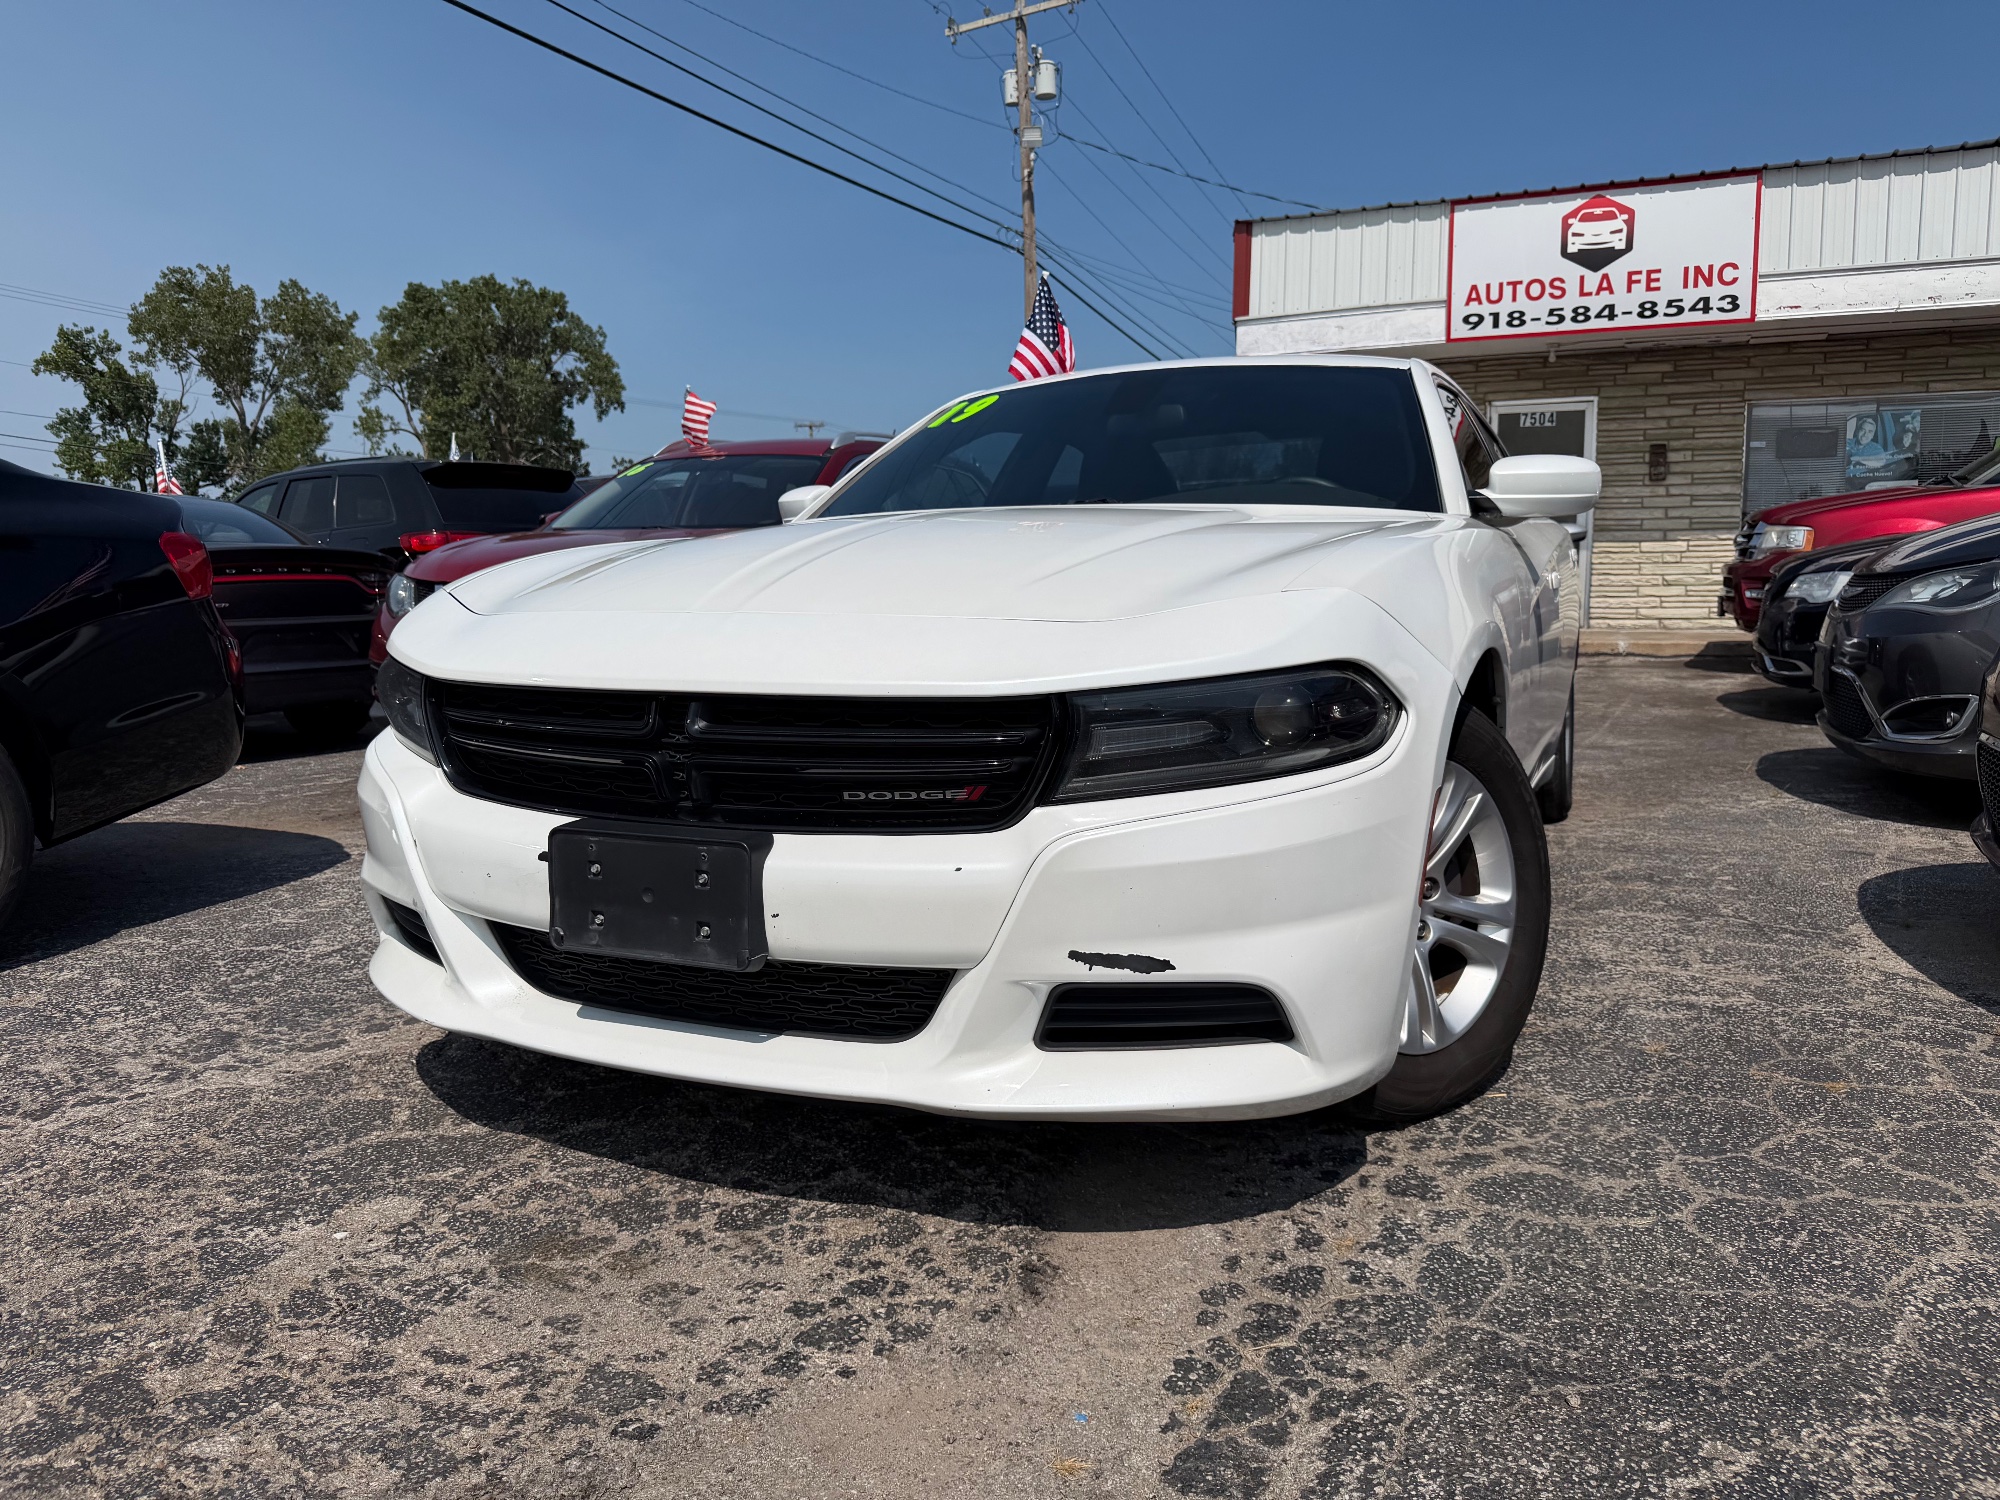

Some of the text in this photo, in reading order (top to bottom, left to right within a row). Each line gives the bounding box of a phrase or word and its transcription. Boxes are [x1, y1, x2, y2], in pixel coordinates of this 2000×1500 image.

[1464, 262, 1740, 307] AUTOS LA FE INC
[1461, 294, 1741, 331] 918-584-8543
[927, 394, 1000, 429] 19
[1521, 412, 1555, 426] 7504
[842, 789, 969, 800] DODGE
